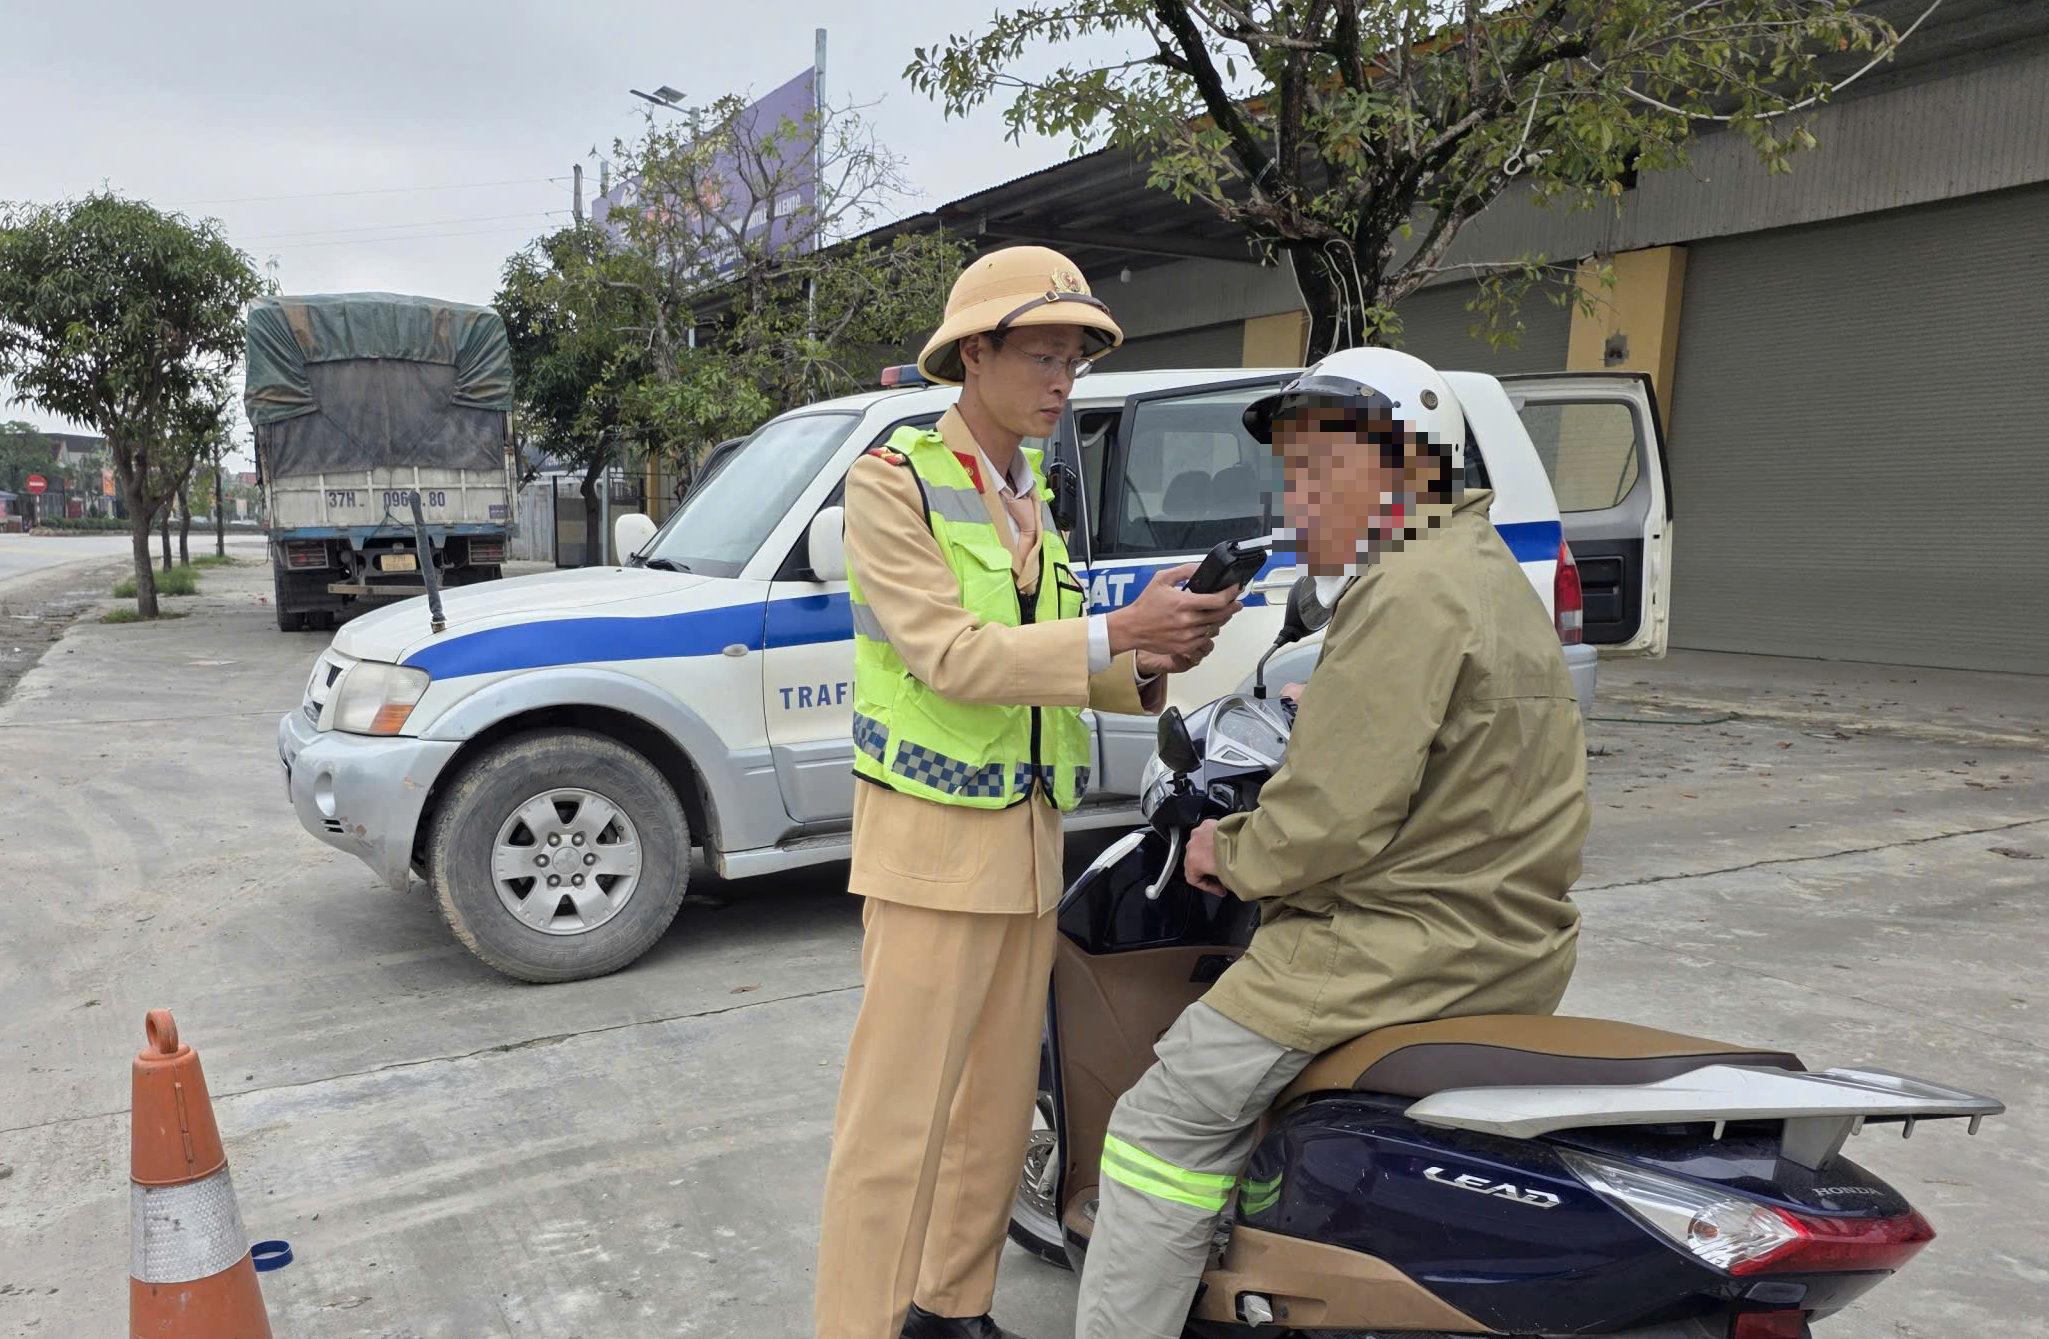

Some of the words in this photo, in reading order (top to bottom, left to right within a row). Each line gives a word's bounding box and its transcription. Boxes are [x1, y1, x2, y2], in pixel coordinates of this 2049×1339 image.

[779, 680, 855, 710] TRAF
[1422, 1166, 1560, 1208] LEAD
[1812, 1186, 1885, 1197] HONDA
